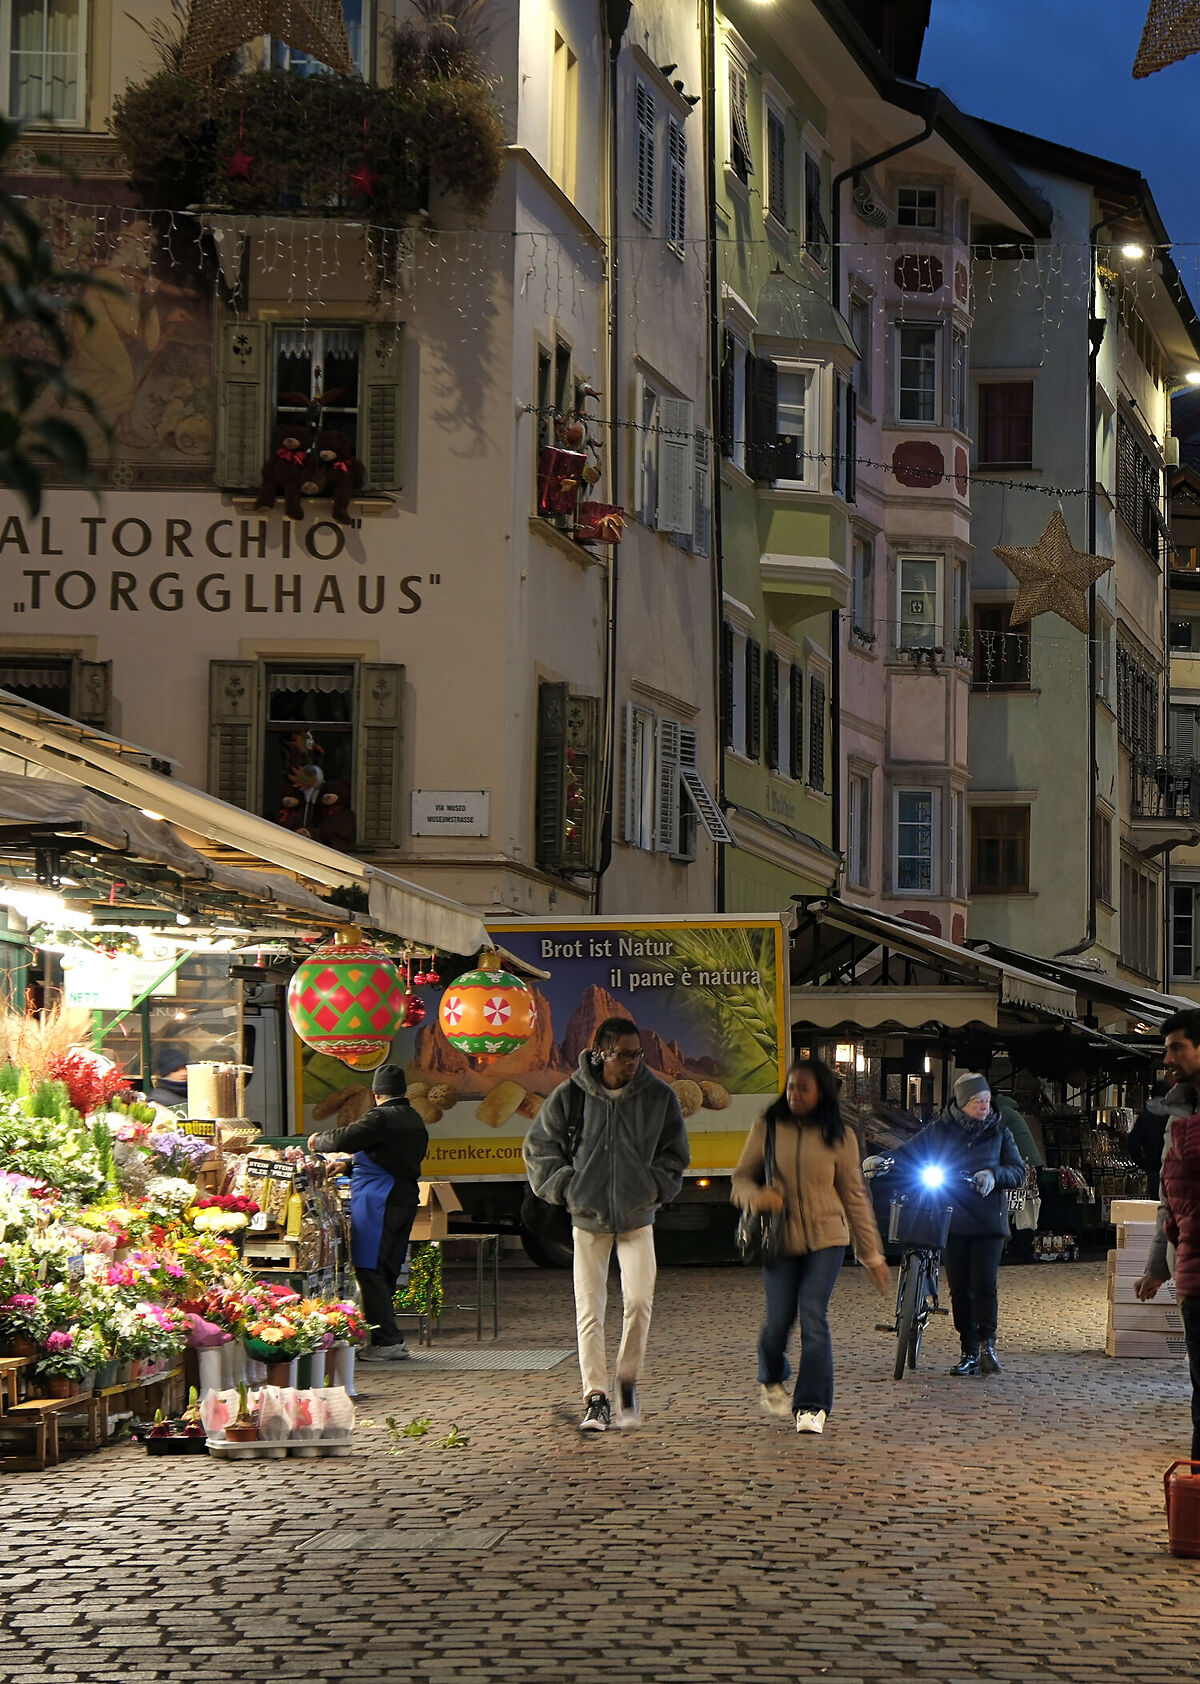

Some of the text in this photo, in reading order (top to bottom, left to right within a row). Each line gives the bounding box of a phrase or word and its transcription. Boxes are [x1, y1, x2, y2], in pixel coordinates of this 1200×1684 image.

[0, 515, 363, 561] AL TORCHIO"
[541, 937, 673, 958] Brot ist Natur
[610, 967, 762, 992] il pane è natura
[247, 1168, 269, 1176] PILZE
[248, 1161, 269, 1169] STEIN
[273, 1164, 294, 1172] STEIN
